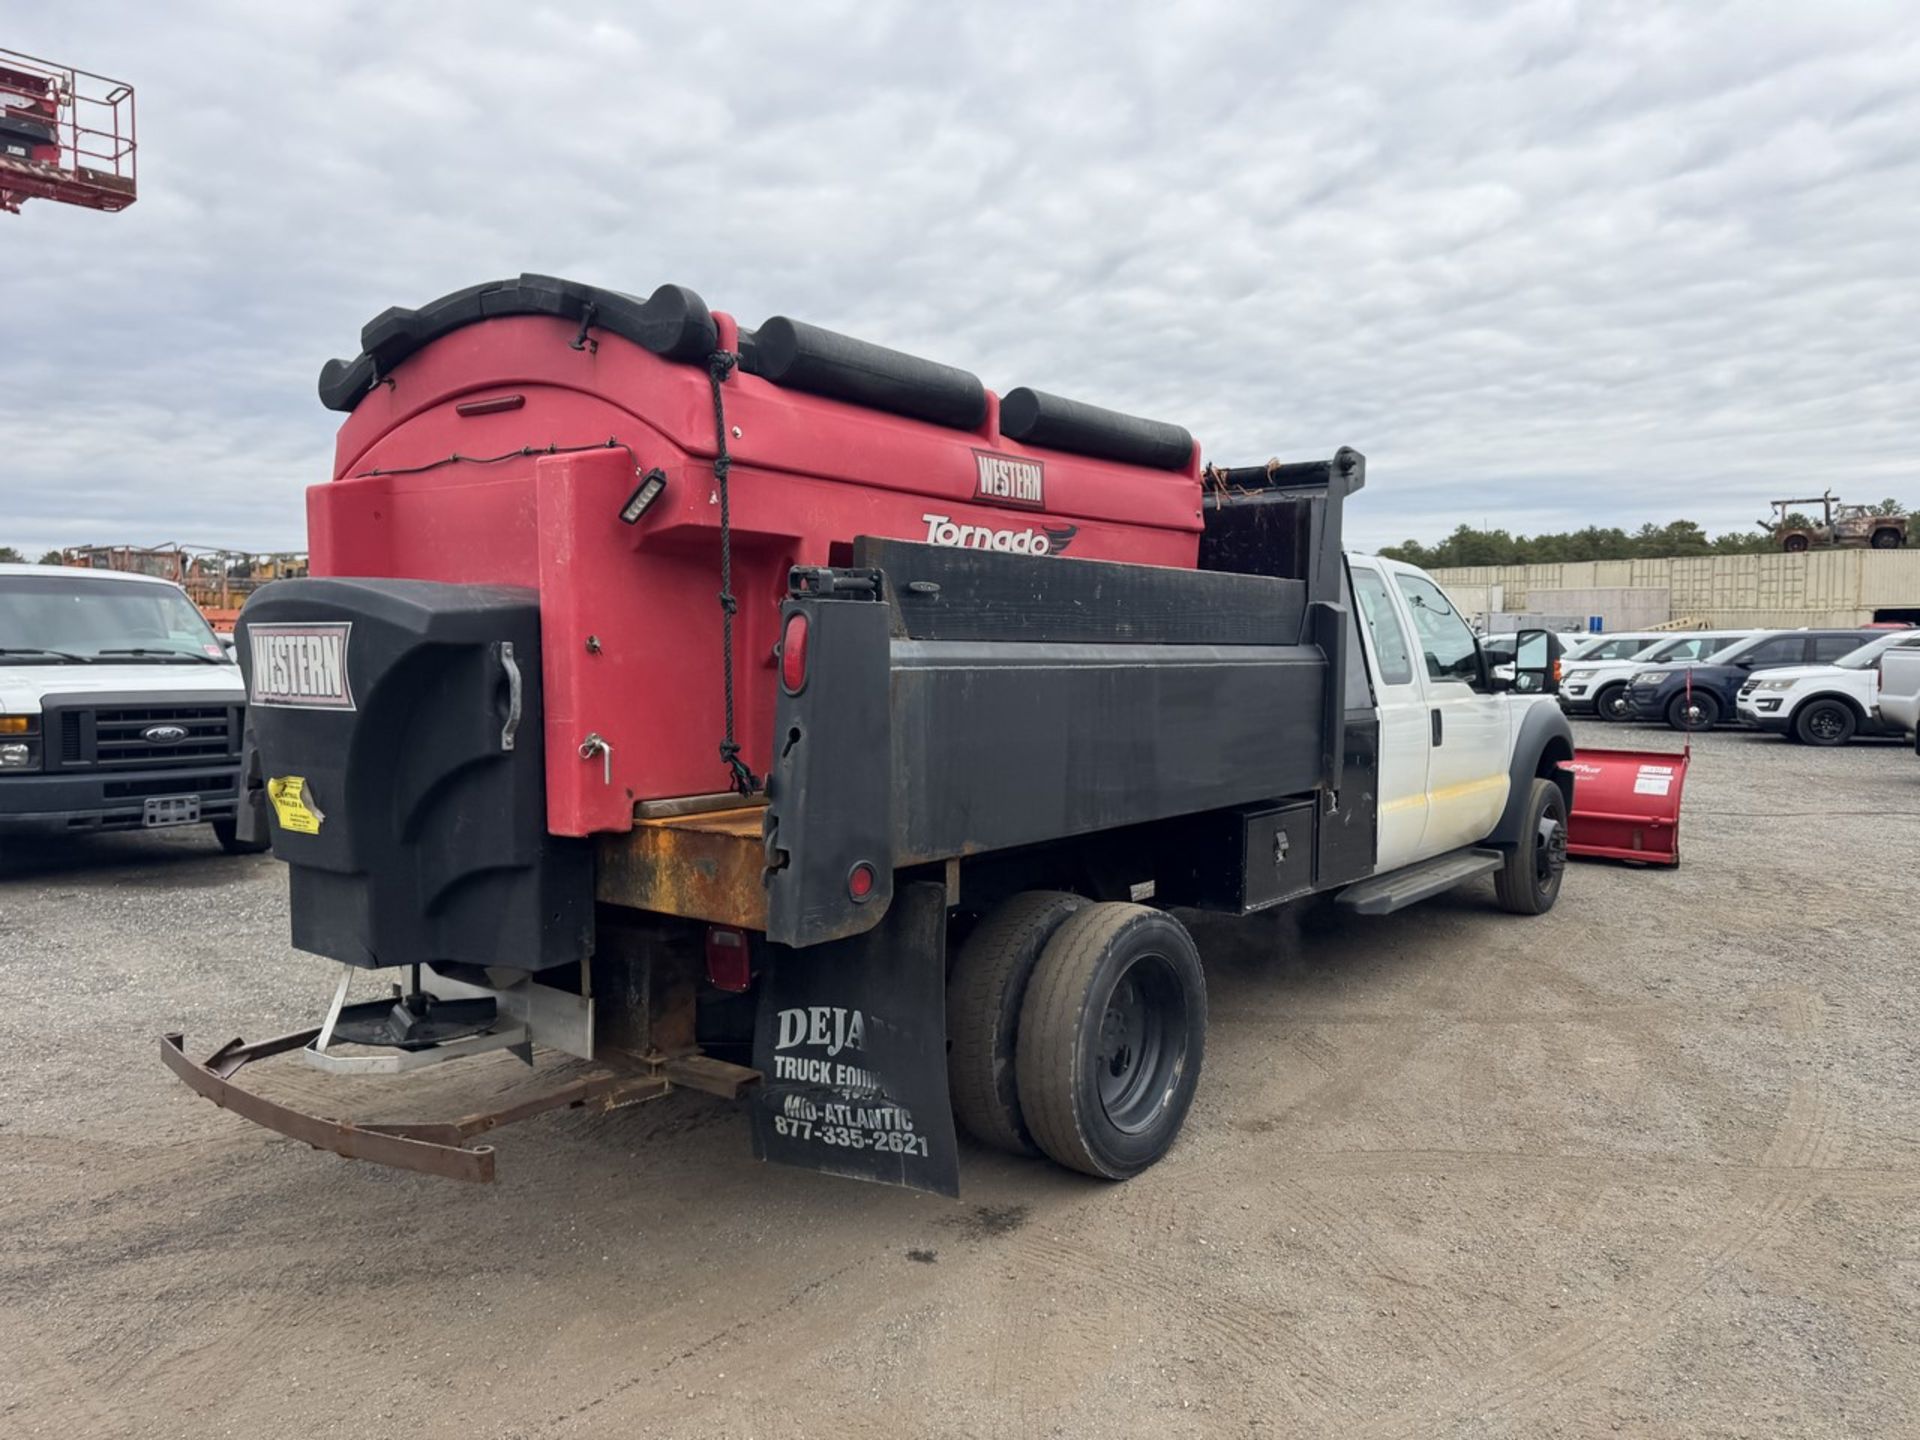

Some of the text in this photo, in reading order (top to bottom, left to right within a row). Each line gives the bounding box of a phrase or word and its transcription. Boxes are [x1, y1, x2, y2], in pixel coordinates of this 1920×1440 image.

[977, 456, 1042, 501] WESTERN
[922, 513, 1050, 556] Tornado
[254, 635, 342, 697] WESTERN
[774, 1055, 832, 1085] TRUCK
[784, 1094, 914, 1132] MID-ATLANTIC
[775, 1115, 928, 1157] 877-335-2621
